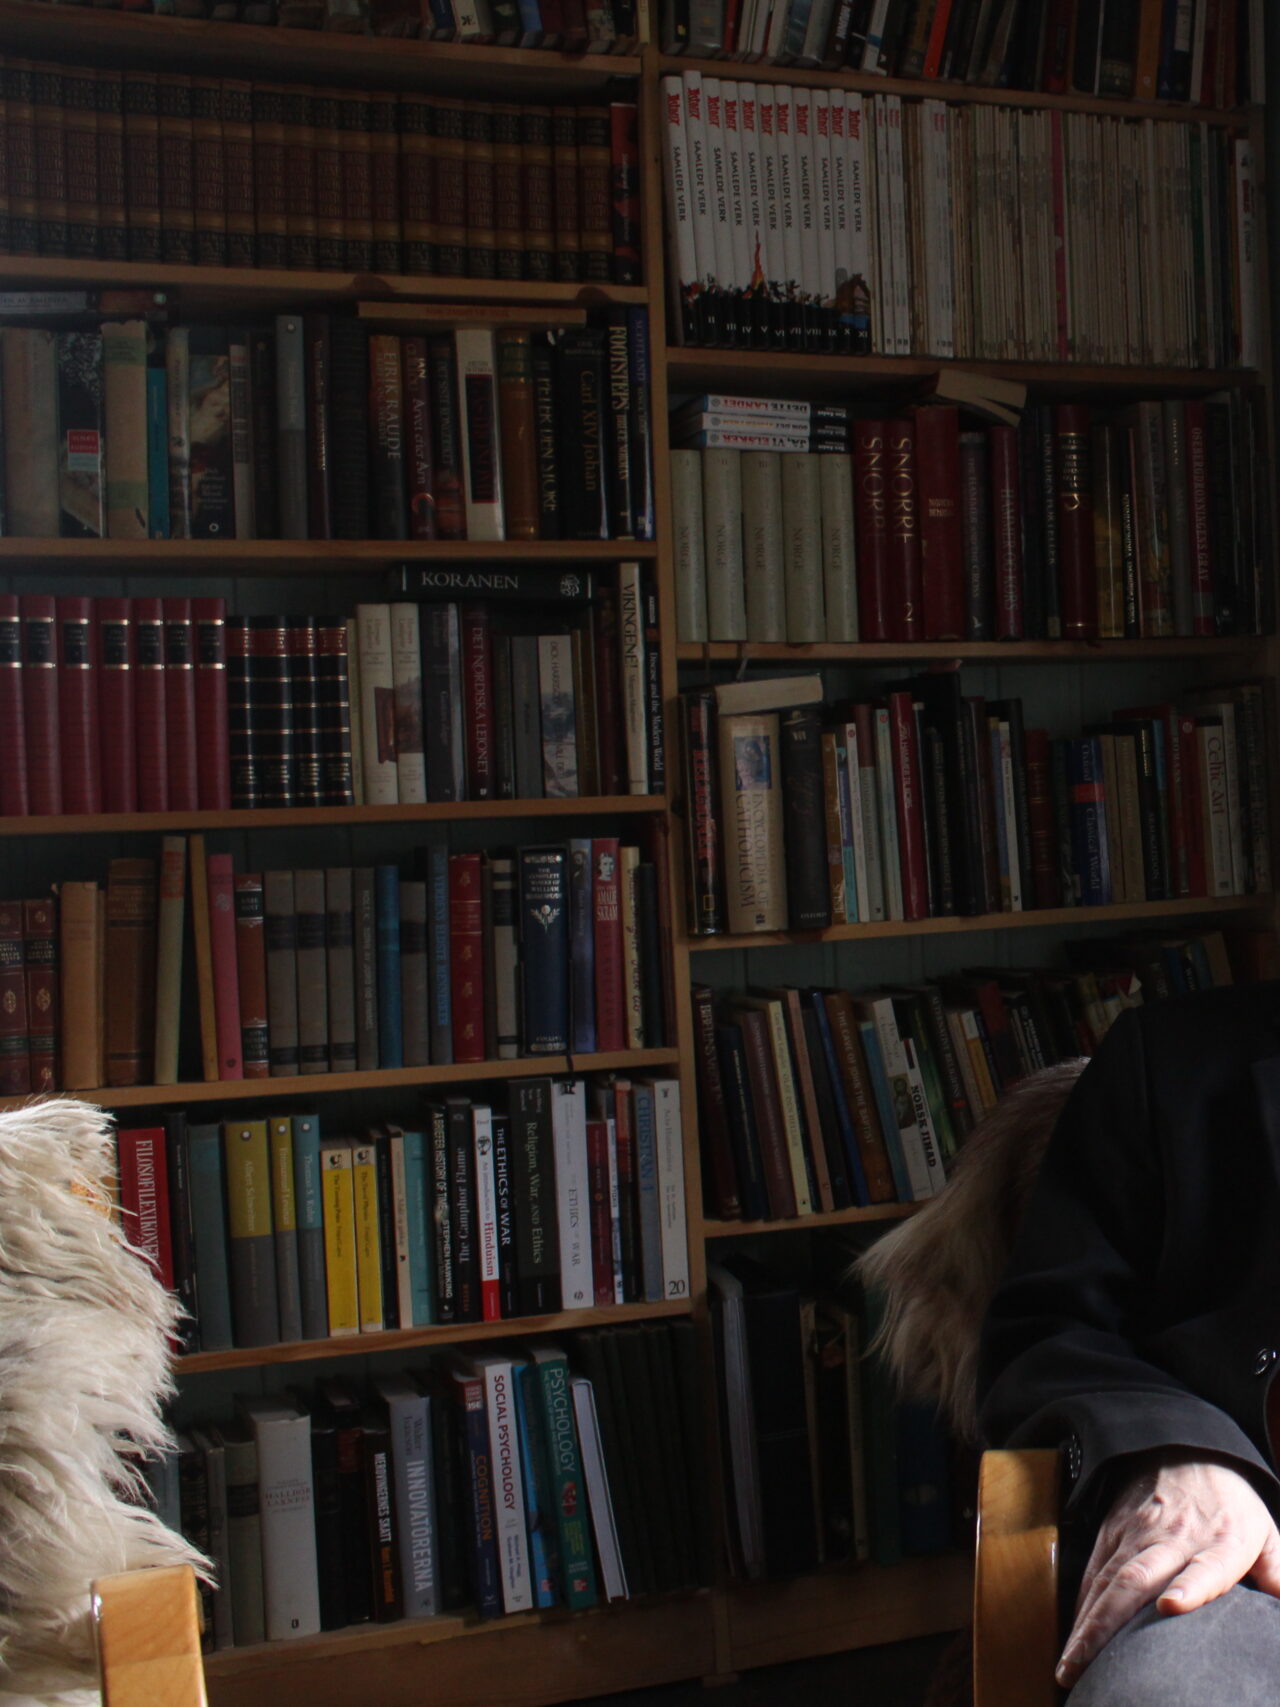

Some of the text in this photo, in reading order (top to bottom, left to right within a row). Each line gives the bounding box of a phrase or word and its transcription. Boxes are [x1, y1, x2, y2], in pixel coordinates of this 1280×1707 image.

[673, 146, 684, 193] SAMLEDE
[694, 140, 706, 216] SAMLEDE VERK
[714, 148, 726, 222] SAMLEDE VERK
[730, 151, 740, 199] SAMLEDE
[748, 152, 758, 199] SAMLEDE
[766, 156, 777, 230] SAMLEDE VERK
[782, 154, 791, 201] SAMLEDE
[801, 155, 811, 229] SAMLEDE VERK
[822, 157, 830, 204] SAMLEDE
[836, 157, 844, 203] SAMLEDE
[608, 325, 630, 410] FOOTSTEPS
[384, 352, 400, 460] EIRIK RAUDE
[580, 370, 599, 491] Carl XIV Johan
[891, 436, 915, 545] SNORRE
[1000, 489, 1016, 549] HAMMER
[421, 571, 519, 590] KORANEN
[903, 601, 915, 622] 2
[472, 626, 484, 650] DET
[621, 583, 638, 670] VIKINGENE!
[471, 653, 488, 719] NORDISKA
[649, 652, 664, 771] Disease and the Modern World
[1207, 736, 1225, 816] Celtic Art
[736, 794, 755, 907] CATHOLICISM
[752, 793, 768, 885] ENCYCLOPEDIA
[1085, 807, 1100, 889] Classical World
[836, 1010, 848, 1030] THE
[840, 1031, 852, 1053] CAVE
[853, 1090, 864, 1107] THE
[858, 1108, 874, 1145] BAPTIST
[911, 1085, 936, 1168] NORSK JIHAD
[433, 1119, 445, 1149] BRIEFER
[434, 1150, 446, 1180] HISTORY
[524, 1121, 539, 1172] Religion,
[637, 1096, 654, 1179] CHRISTIAN
[436, 1182, 447, 1191] OF
[455, 1147, 470, 1264] The Camphor Flame
[496, 1128, 511, 1246] THE ETHICS OF WAR
[528, 1173, 540, 1201] War,
[567, 1188, 579, 1229] ETHICS
[440, 1219, 453, 1299] STEPHEN HAWKING
[483, 1221, 496, 1277] Hinduism
[532, 1227, 544, 1264] Ethics
[669, 1280, 685, 1295] 20
[494, 1375, 516, 1511] SOCIAL PSYCHOLOGY
[550, 1368, 577, 1473] PSYCHOLOGY
[405, 1460, 433, 1593] INNOVATÖRERNA
[475, 1455, 493, 1541] COGNITION
[379, 1518, 392, 1543] SKATT
